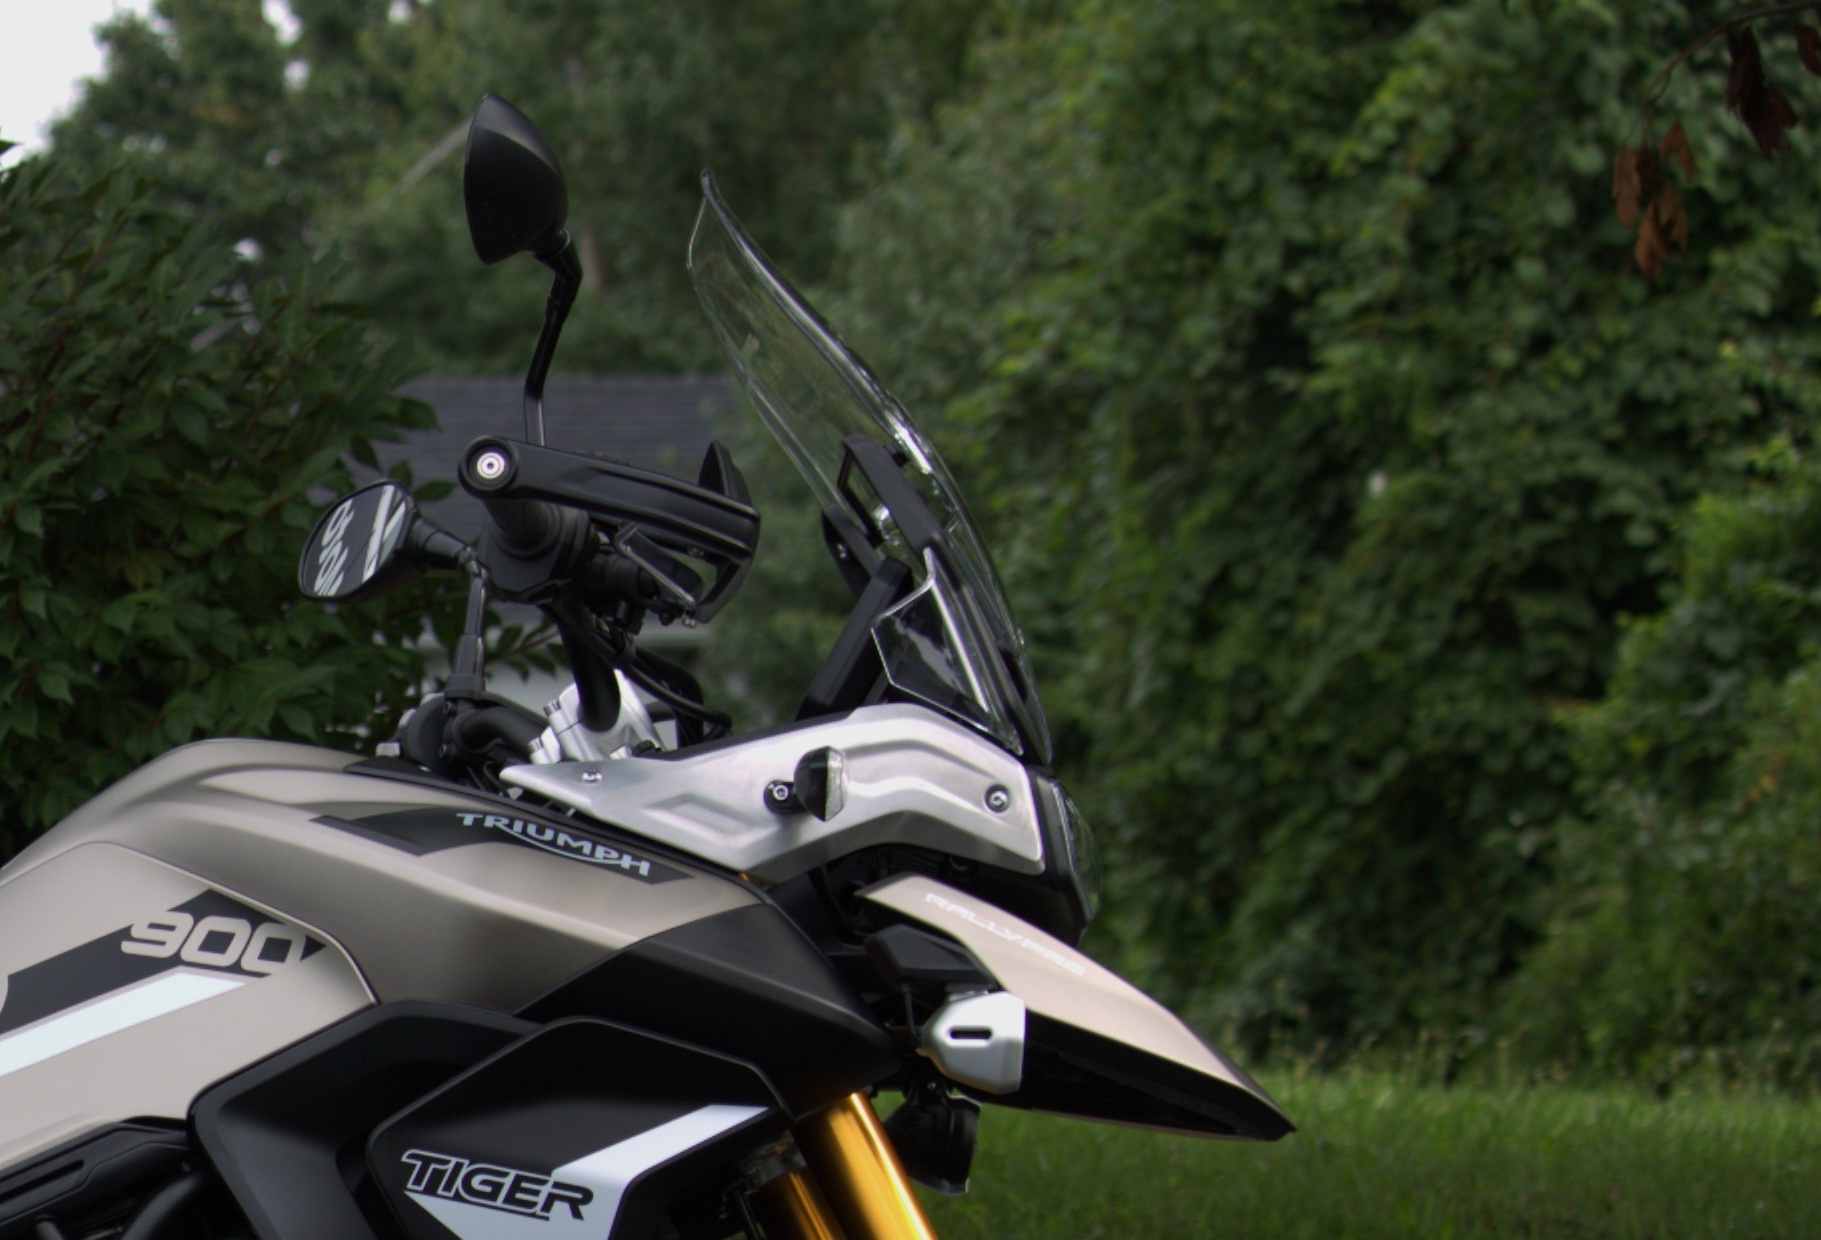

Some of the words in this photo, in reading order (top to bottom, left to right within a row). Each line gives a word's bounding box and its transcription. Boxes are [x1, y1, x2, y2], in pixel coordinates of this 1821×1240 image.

[455, 812, 650, 877] TRIUMPH
[120, 910, 307, 976] 900
[401, 1149, 594, 1221] TIGER
